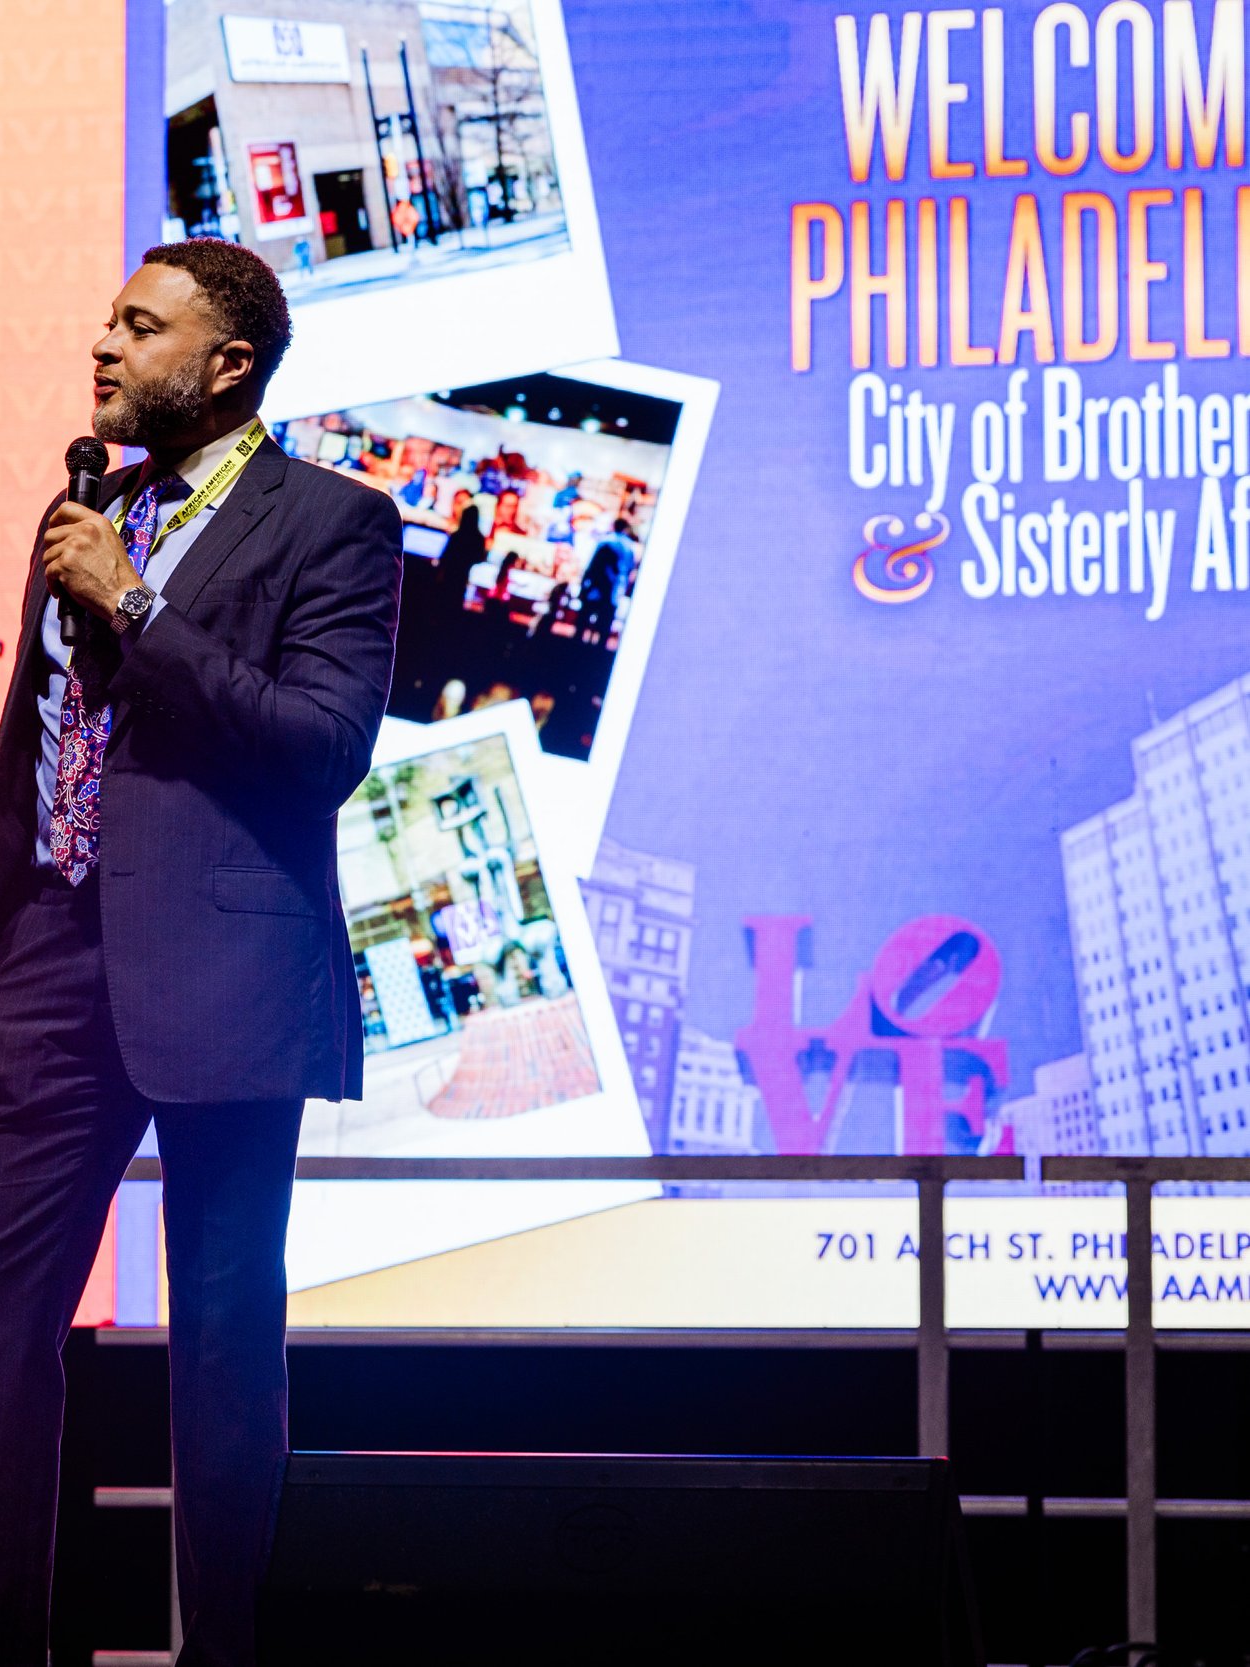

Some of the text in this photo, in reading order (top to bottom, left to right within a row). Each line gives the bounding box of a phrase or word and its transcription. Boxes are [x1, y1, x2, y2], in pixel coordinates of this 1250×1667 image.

[834, 0, 1247, 182] WELCOM
[182, 459, 233, 516] AFRICAN AMERICAN
[849, 371, 955, 513] City
[970, 368, 1029, 485] of
[183, 498, 204, 519] MUSEUM
[207, 463, 237, 494] PHILADELPHIA
[852, 512, 950, 604] &
[960, 478, 1176, 621] Sisterly
[816, 1231, 1250, 1260] 701 ACH ST. PHIADELP
